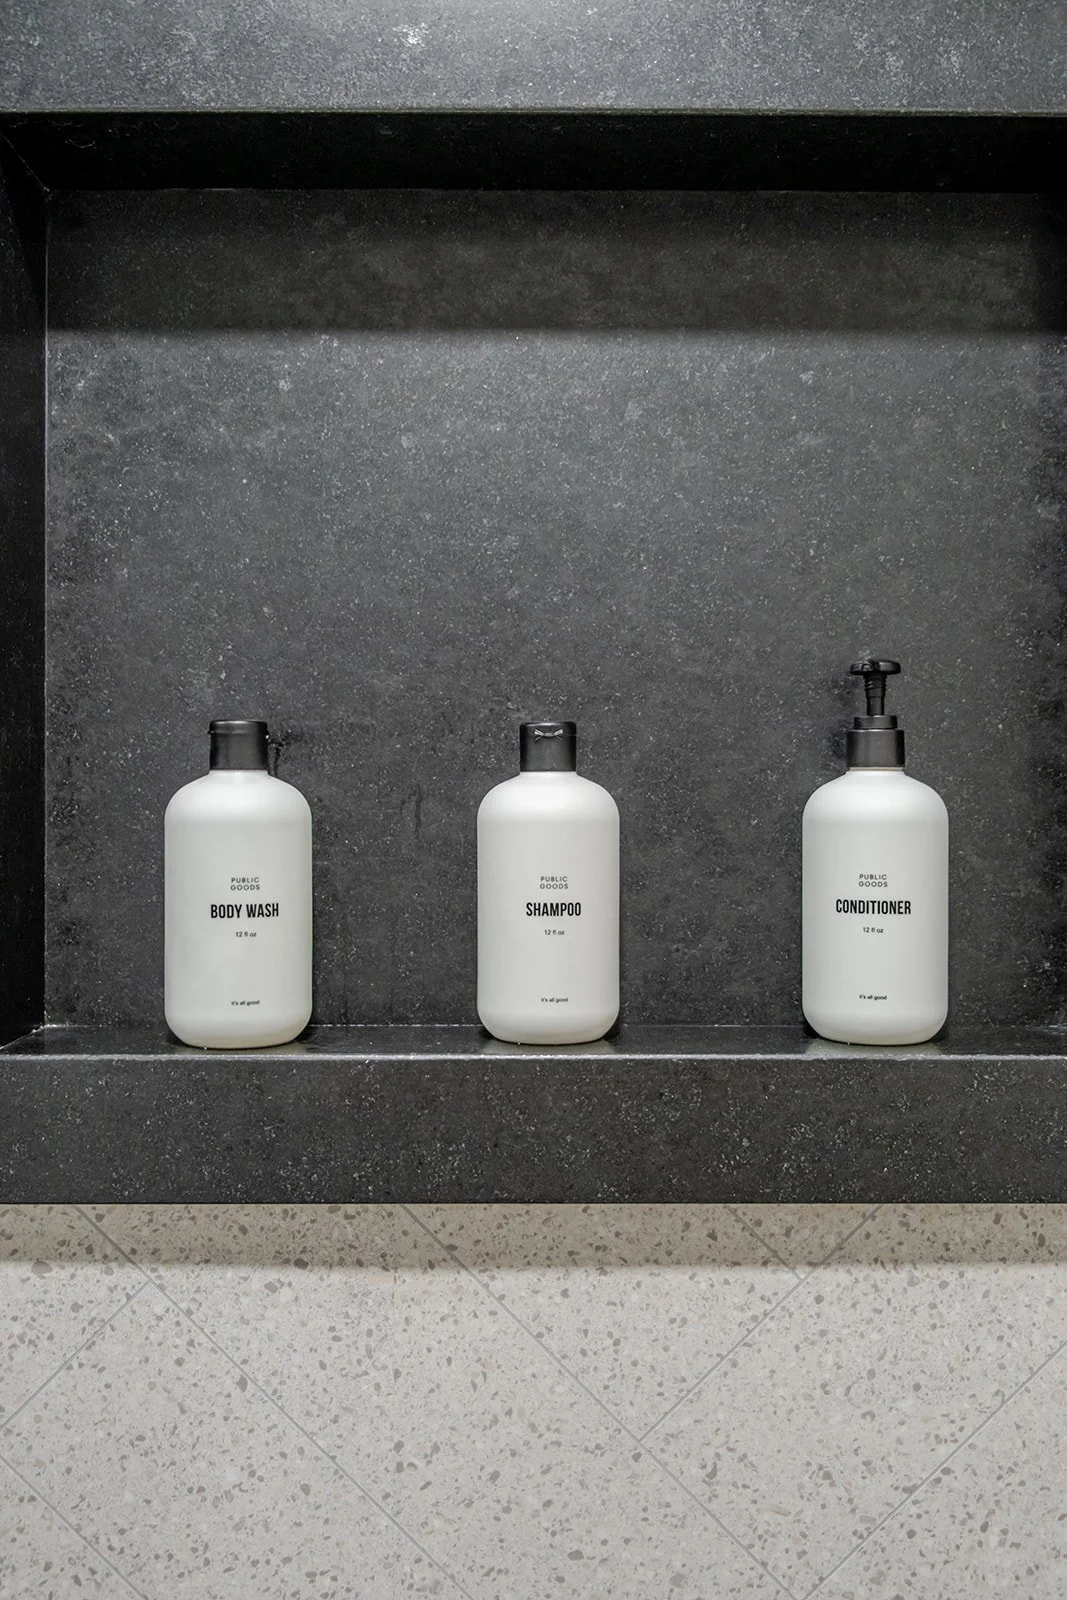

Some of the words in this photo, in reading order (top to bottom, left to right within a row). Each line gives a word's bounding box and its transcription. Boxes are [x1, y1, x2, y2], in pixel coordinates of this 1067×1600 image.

[230, 876, 260, 884] PUBLIC
[540, 875, 568, 883] PUBLIC
[859, 873, 888, 881] PUBLIC
[229, 884, 261, 892] GOODS
[210, 903, 243, 919] BODY
[245, 902, 280, 918] WASH
[525, 902, 582, 917] SHAMPOO
[835, 898, 912, 915] CONDITIONER
[544, 928, 552, 936] 12
[862, 926, 870, 934] 12
